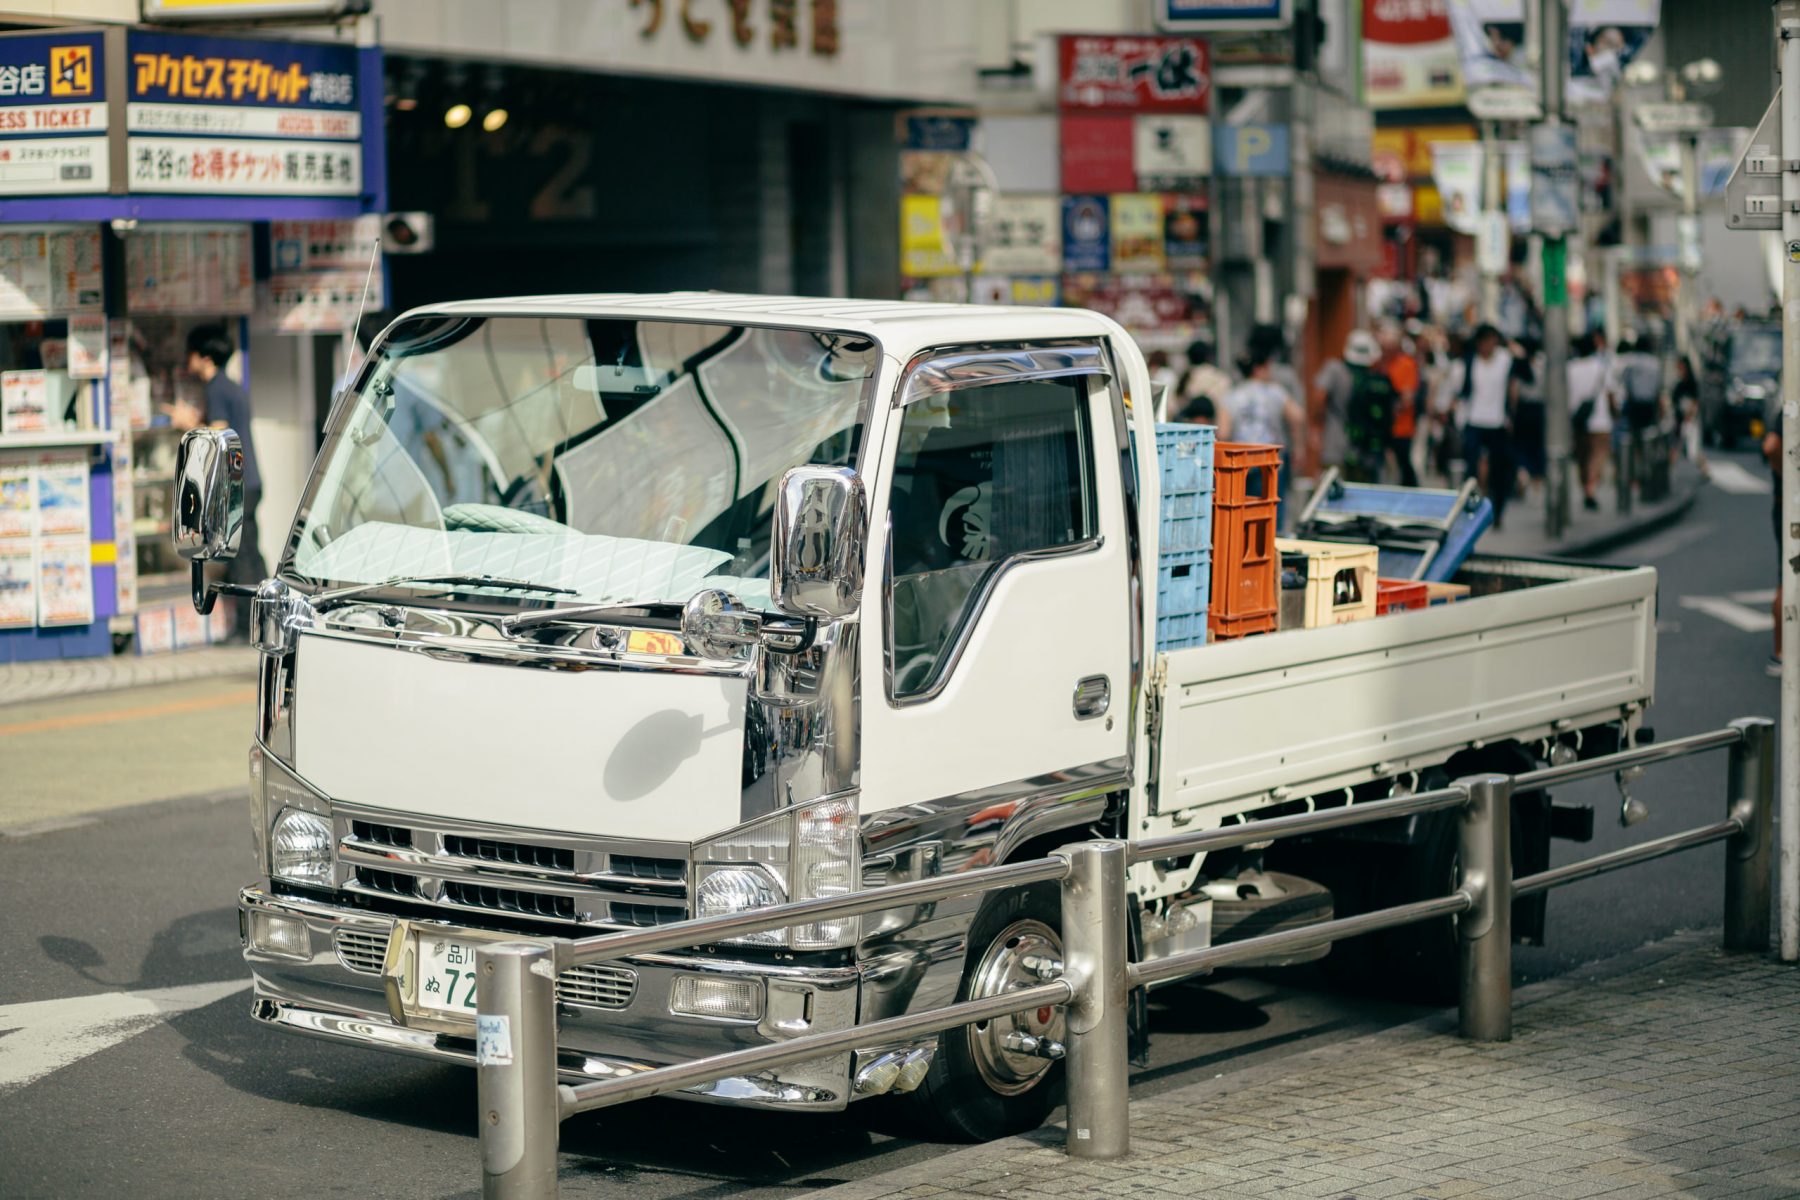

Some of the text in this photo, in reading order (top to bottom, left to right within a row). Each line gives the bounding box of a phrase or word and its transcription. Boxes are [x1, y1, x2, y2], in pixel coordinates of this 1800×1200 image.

[134, 53, 309, 103] アクセスチケット
[34, 106, 92, 129] TICKET
[1237, 127, 1271, 169] P
[425, 975, 441, 994] ぬ
